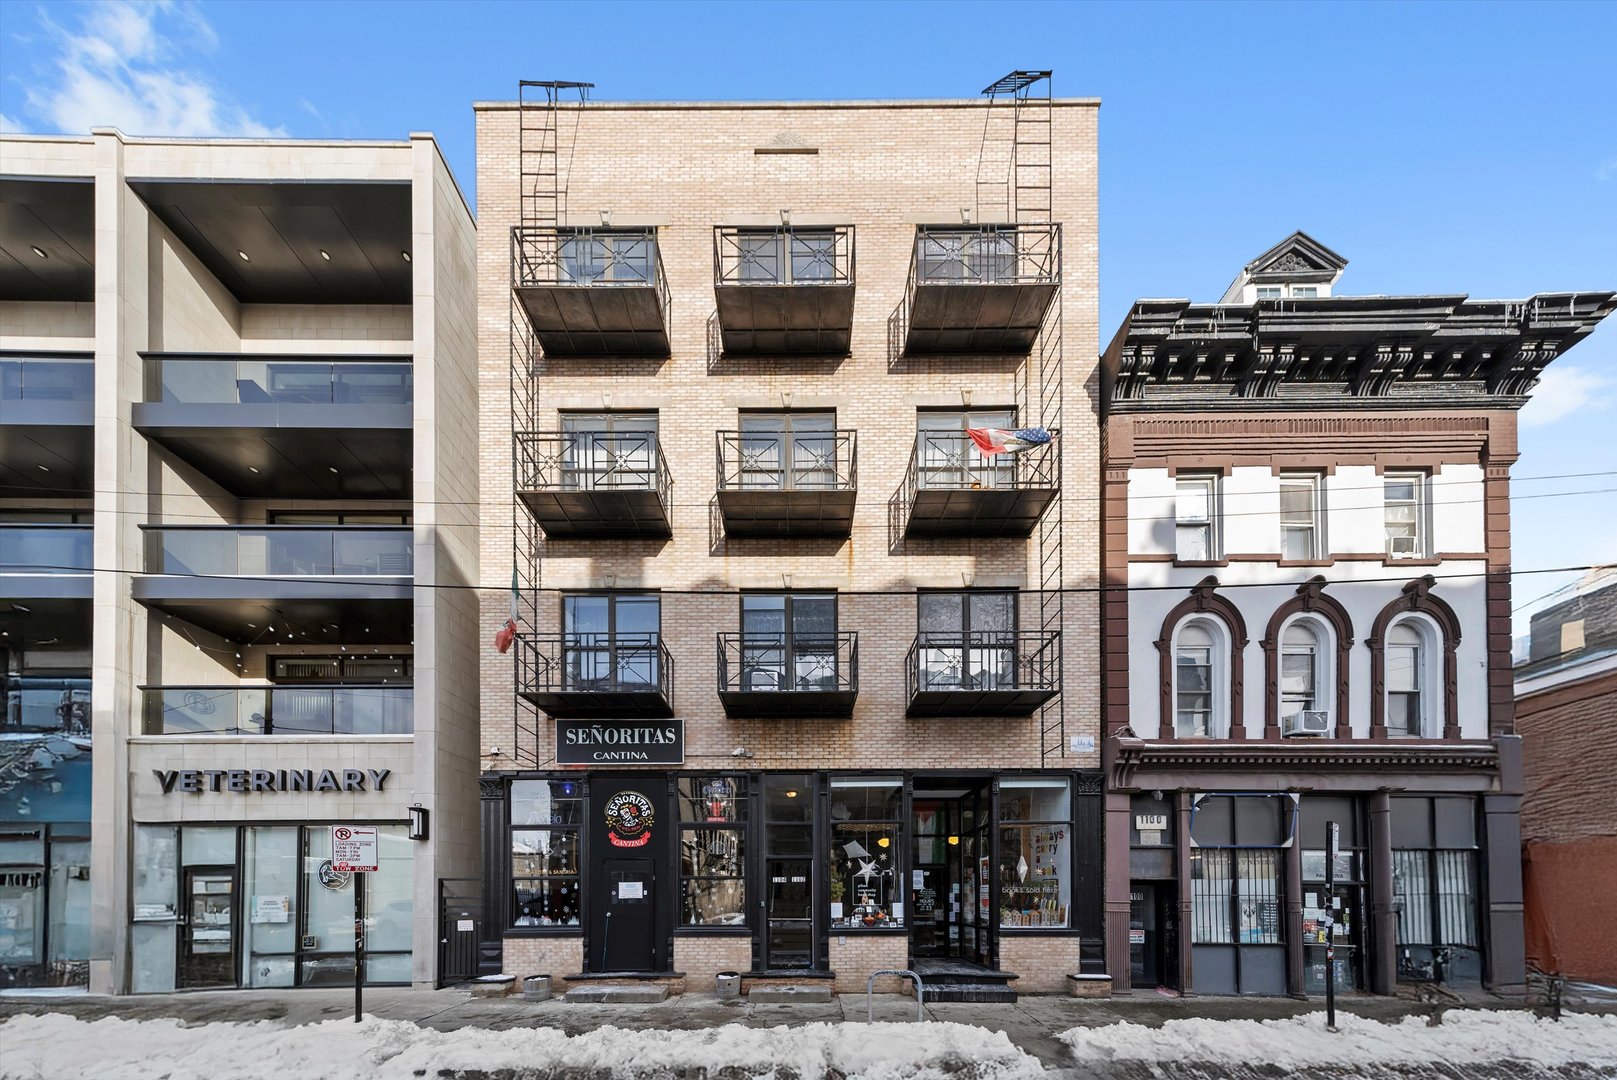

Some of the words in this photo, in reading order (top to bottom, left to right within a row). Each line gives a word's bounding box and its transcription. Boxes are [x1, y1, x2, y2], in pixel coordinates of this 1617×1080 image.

[566, 724, 676, 745] SEÑORITAS
[593, 751, 648, 760] CANTINA
[152, 768, 391, 794] VETERINARY
[608, 795, 651, 817] SEÑORITAS
[1140, 815, 1162, 824] 1100
[1035, 831, 1064, 842] always
[1036, 844, 1057, 855] carry
